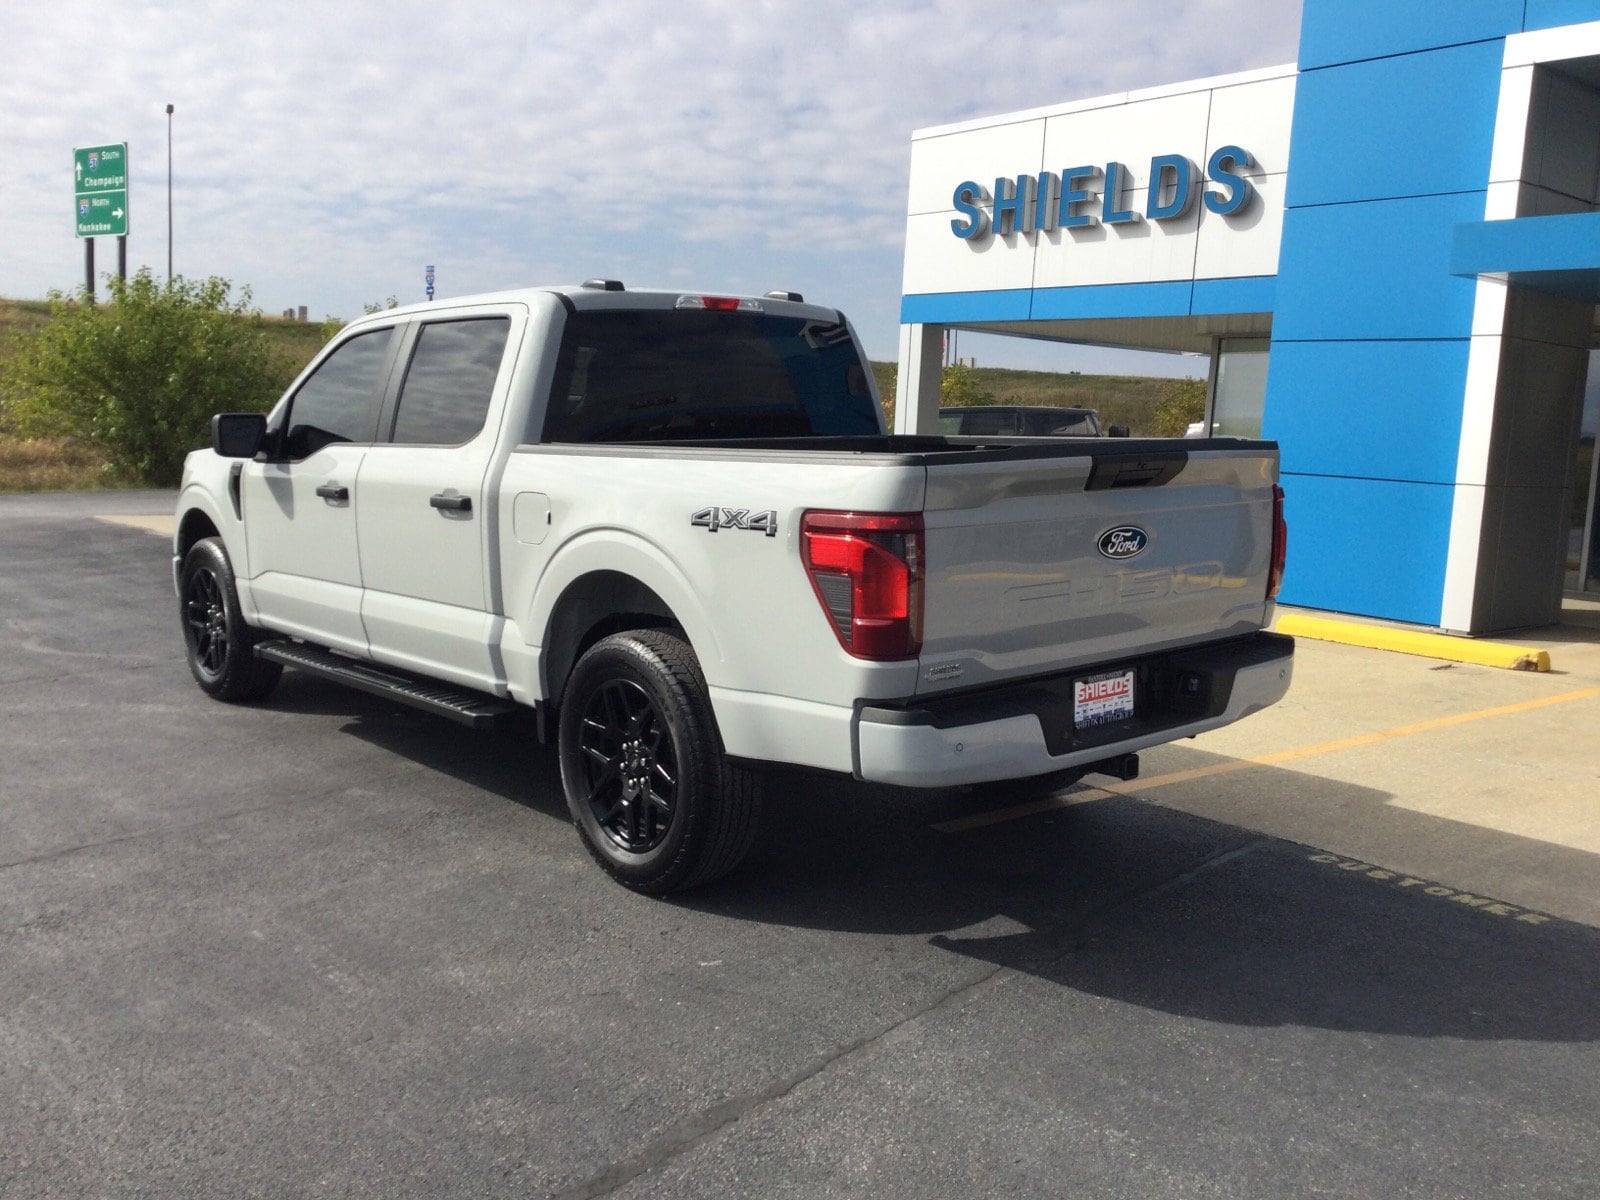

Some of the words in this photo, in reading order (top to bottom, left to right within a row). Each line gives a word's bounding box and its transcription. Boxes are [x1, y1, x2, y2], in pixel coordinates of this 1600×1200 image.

[84, 176, 124, 187] Champaign
[951, 145, 1249, 240] SHIELDS
[78, 223, 111, 232] Kankakee
[1077, 677, 1131, 702] SHIELDS
